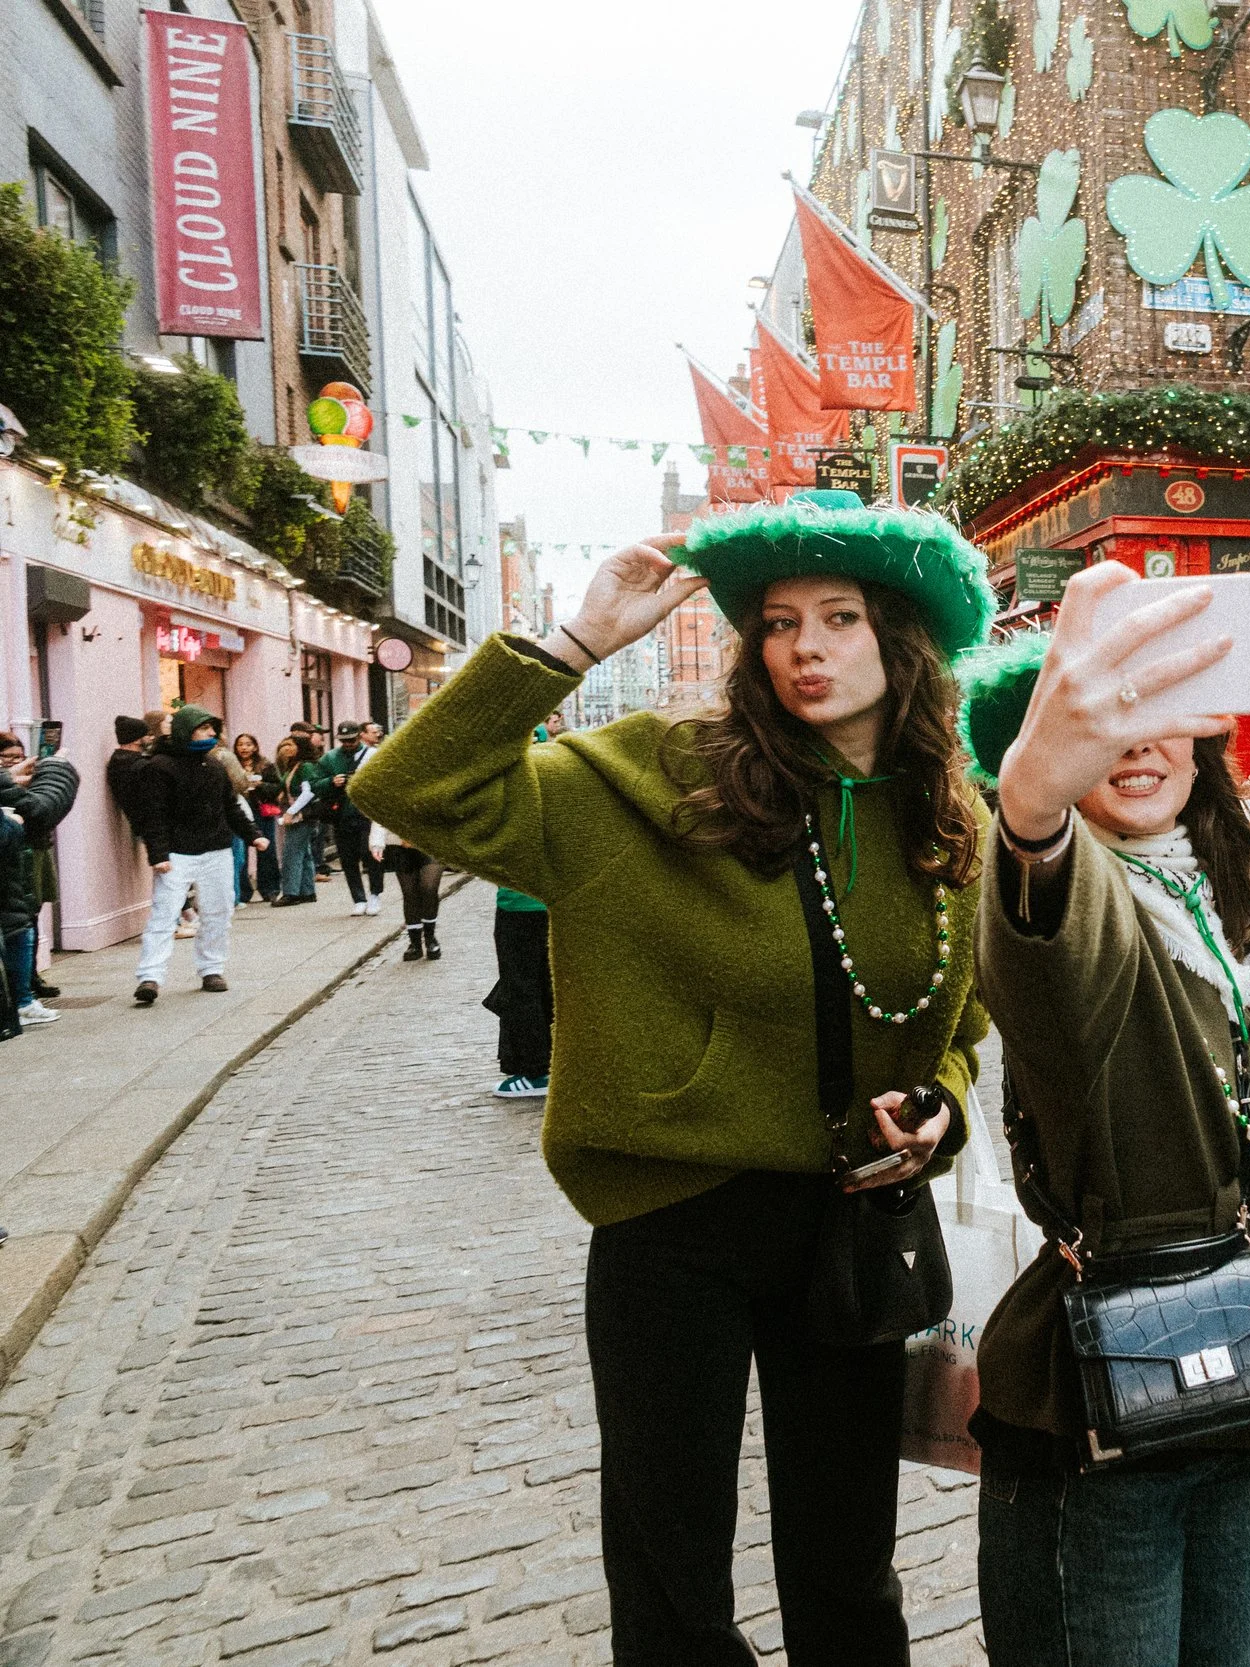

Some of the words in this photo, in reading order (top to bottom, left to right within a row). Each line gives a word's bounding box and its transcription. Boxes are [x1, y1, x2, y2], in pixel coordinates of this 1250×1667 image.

[166, 27, 228, 136] NINE
[174, 150, 239, 292] CLOUD
[847, 340, 884, 355] THE
[847, 372, 893, 389] BAR
[793, 432, 824, 443] THE
[793, 457, 817, 469] BA
[835, 459, 853, 467] THE
[818, 465, 870, 479] TEMPLE
[830, 478, 860, 490] BAR
[1171, 487, 1198, 505] 48
